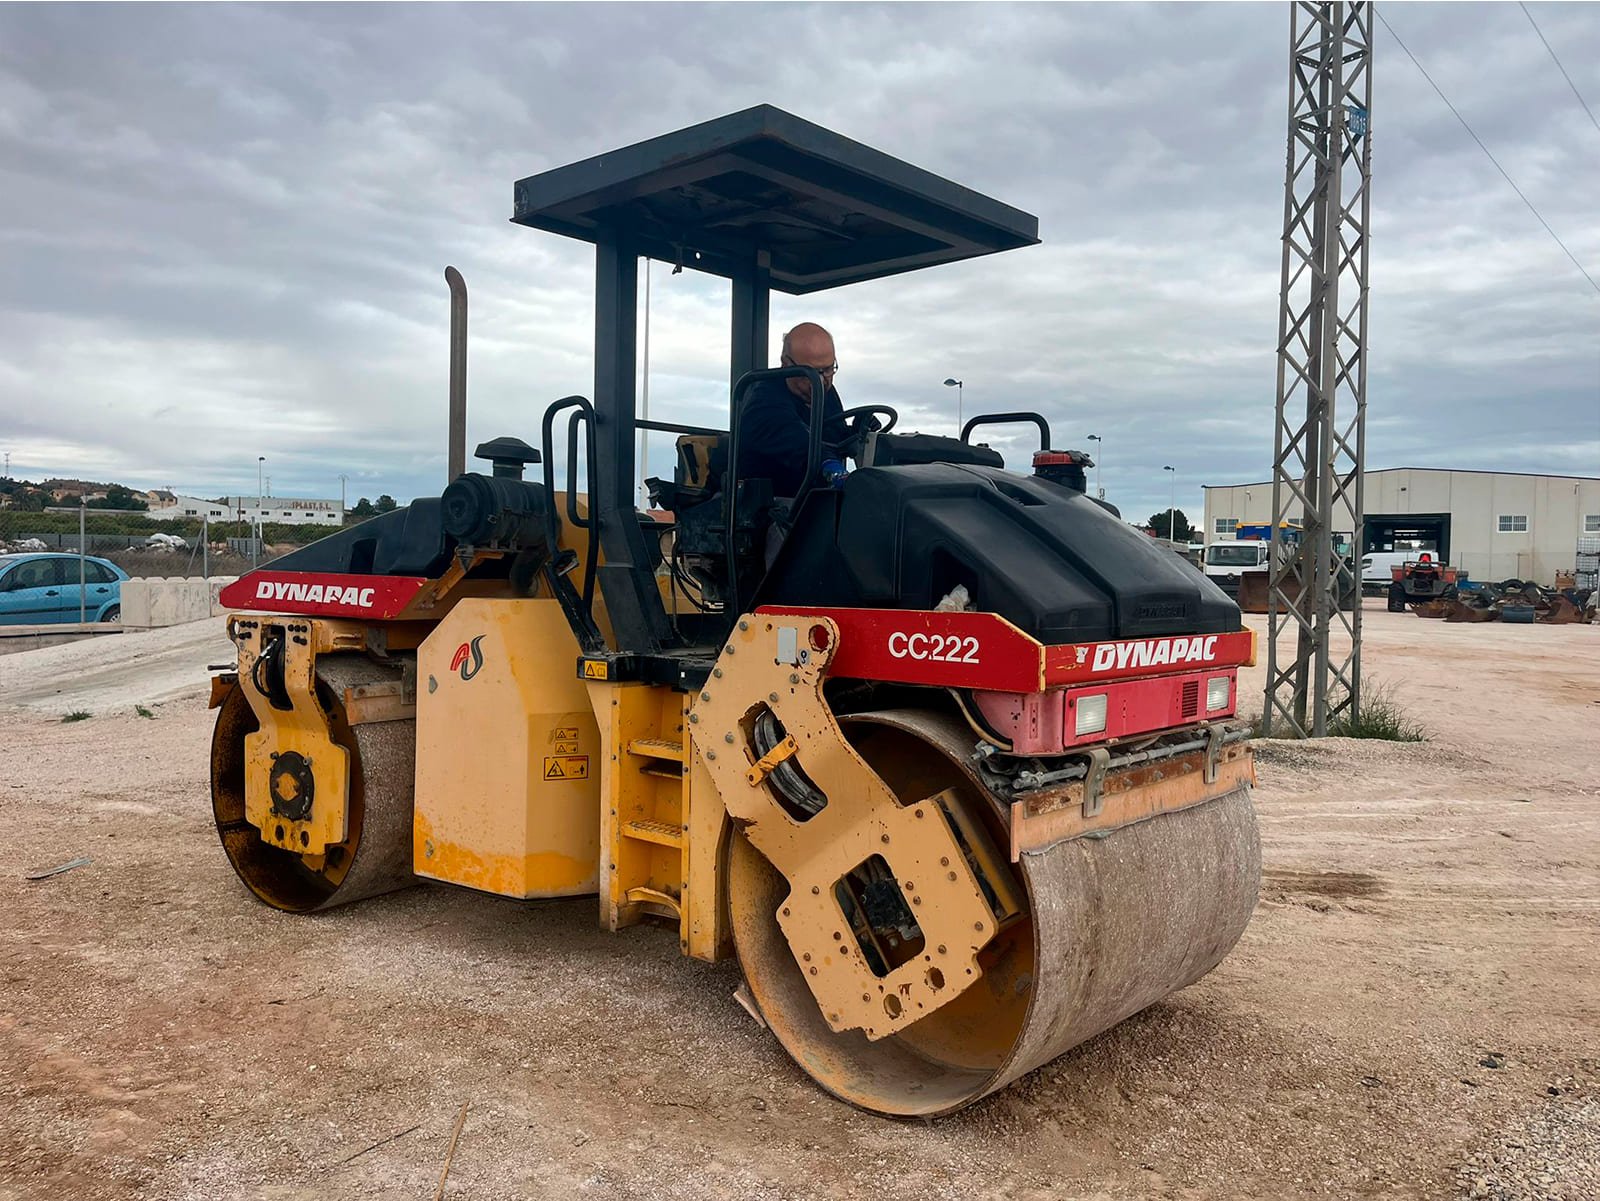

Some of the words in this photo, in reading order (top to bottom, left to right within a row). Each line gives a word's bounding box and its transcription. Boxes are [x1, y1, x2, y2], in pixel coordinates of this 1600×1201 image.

[256, 581, 375, 607] DYNAPAC
[888, 632, 980, 664] CC222
[1092, 636, 1217, 672] DYNAPAC
